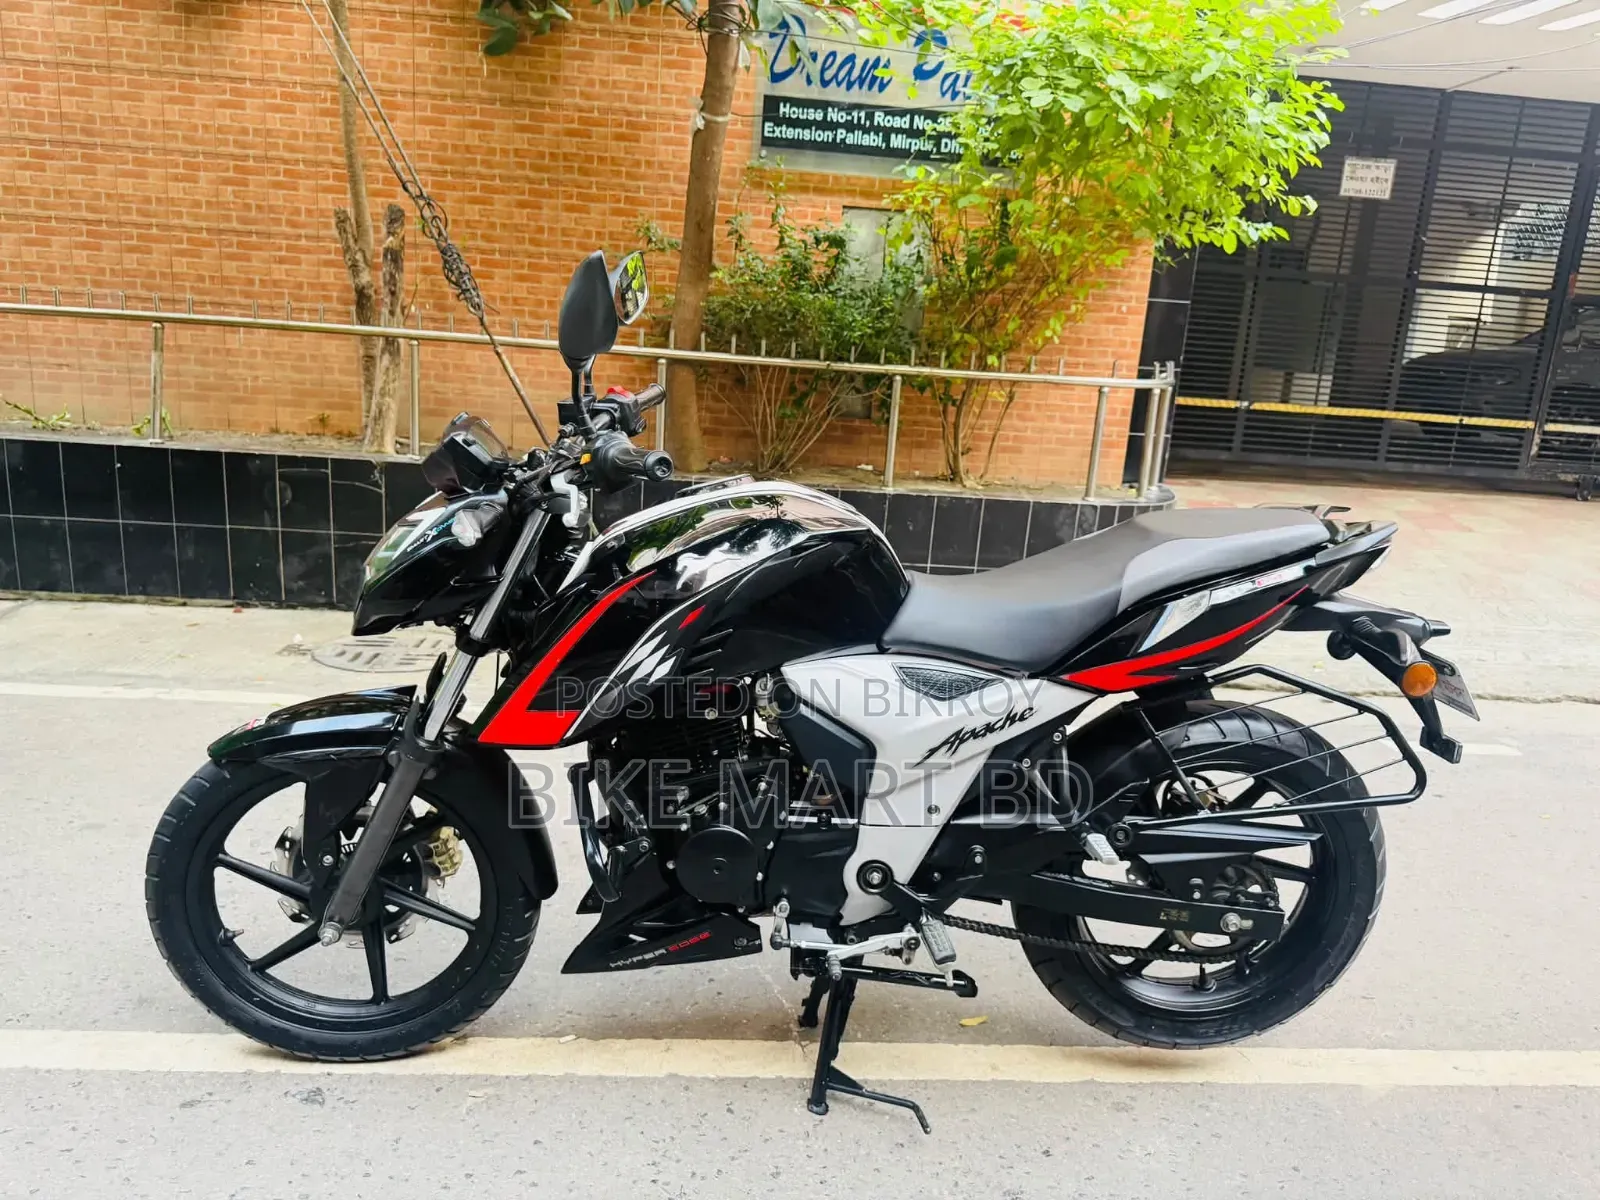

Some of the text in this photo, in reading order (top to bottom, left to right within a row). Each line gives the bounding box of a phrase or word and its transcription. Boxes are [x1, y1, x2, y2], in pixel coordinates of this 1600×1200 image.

[779, 101, 824, 122] House
[826, 106, 870, 127] No-11,
[873, 111, 911, 130] Road
[763, 121, 833, 143] Extension
[836, 128, 886, 149] Pallabi,
[911, 704, 1037, 769] Apache
